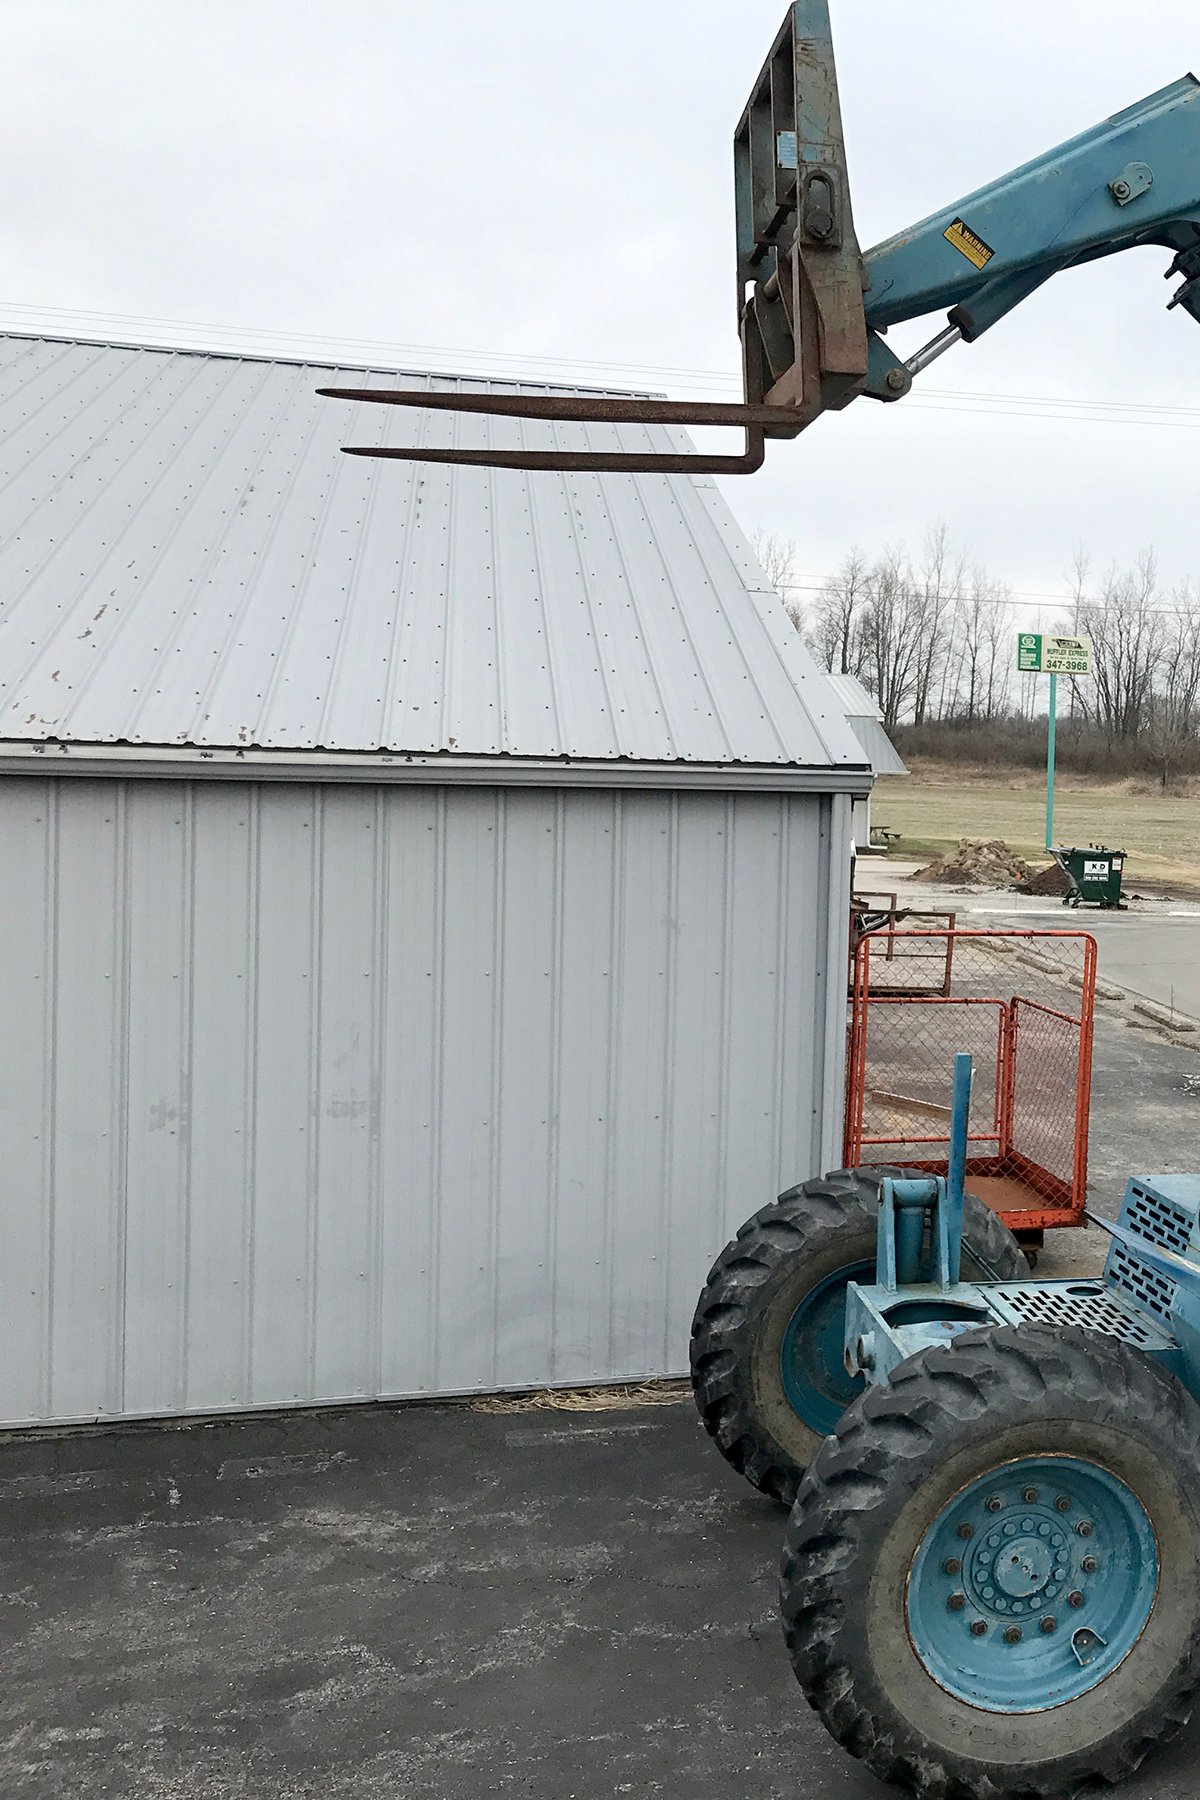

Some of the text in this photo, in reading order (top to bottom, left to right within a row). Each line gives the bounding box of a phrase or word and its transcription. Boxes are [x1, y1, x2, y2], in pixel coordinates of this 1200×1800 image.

[962, 230, 993, 260] WARNING
[1046, 648, 1067, 656] MUFFLER
[1046, 659, 1088, 671] 347-3968
